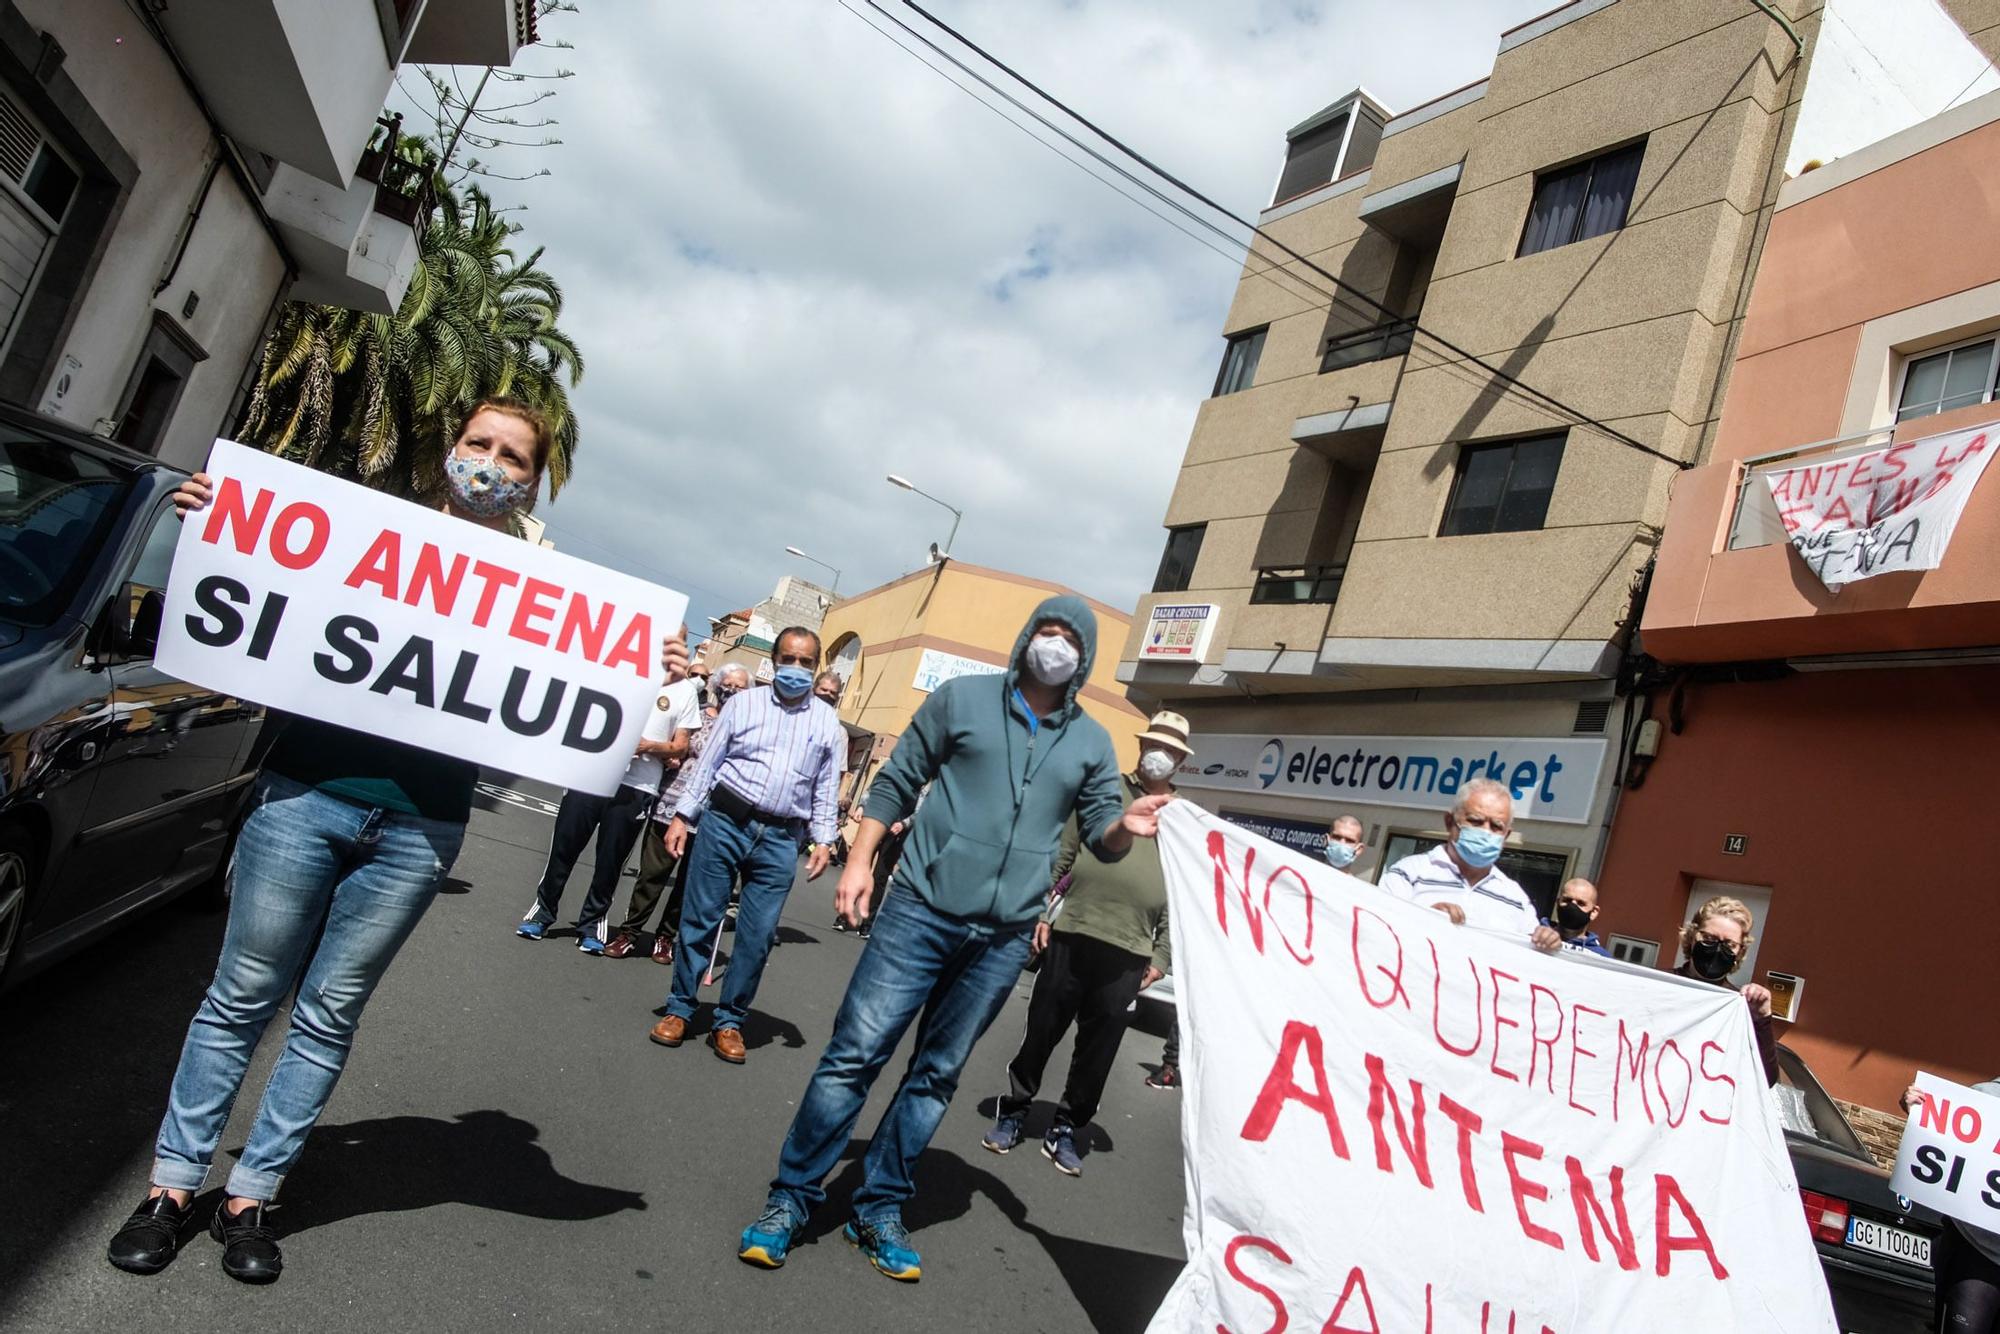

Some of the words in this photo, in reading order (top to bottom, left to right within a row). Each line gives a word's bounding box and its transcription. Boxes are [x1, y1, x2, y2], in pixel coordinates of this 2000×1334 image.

[1771, 442, 1916, 501] ANTES
[1935, 433, 1987, 467] LA
[202, 477, 330, 570] NO
[345, 529, 651, 678] ANTENA
[1154, 608, 1175, 618] BAZAR
[1175, 607, 1207, 618] CRISTINA
[185, 575, 289, 660] SI
[313, 615, 622, 753] SALUD
[1287, 745, 1562, 803] electromarket
[1270, 827, 1287, 841] sus
[1728, 837, 1742, 851] 14
[1207, 831, 1314, 966] NO
[1351, 906, 1736, 1128] QUEREMOS
[1919, 1092, 1982, 1144] NO
[1241, 1020, 1729, 1280] ANTENA
[1910, 1144, 1967, 1194] SI
[1855, 1221, 1929, 1261] GC1100AG
